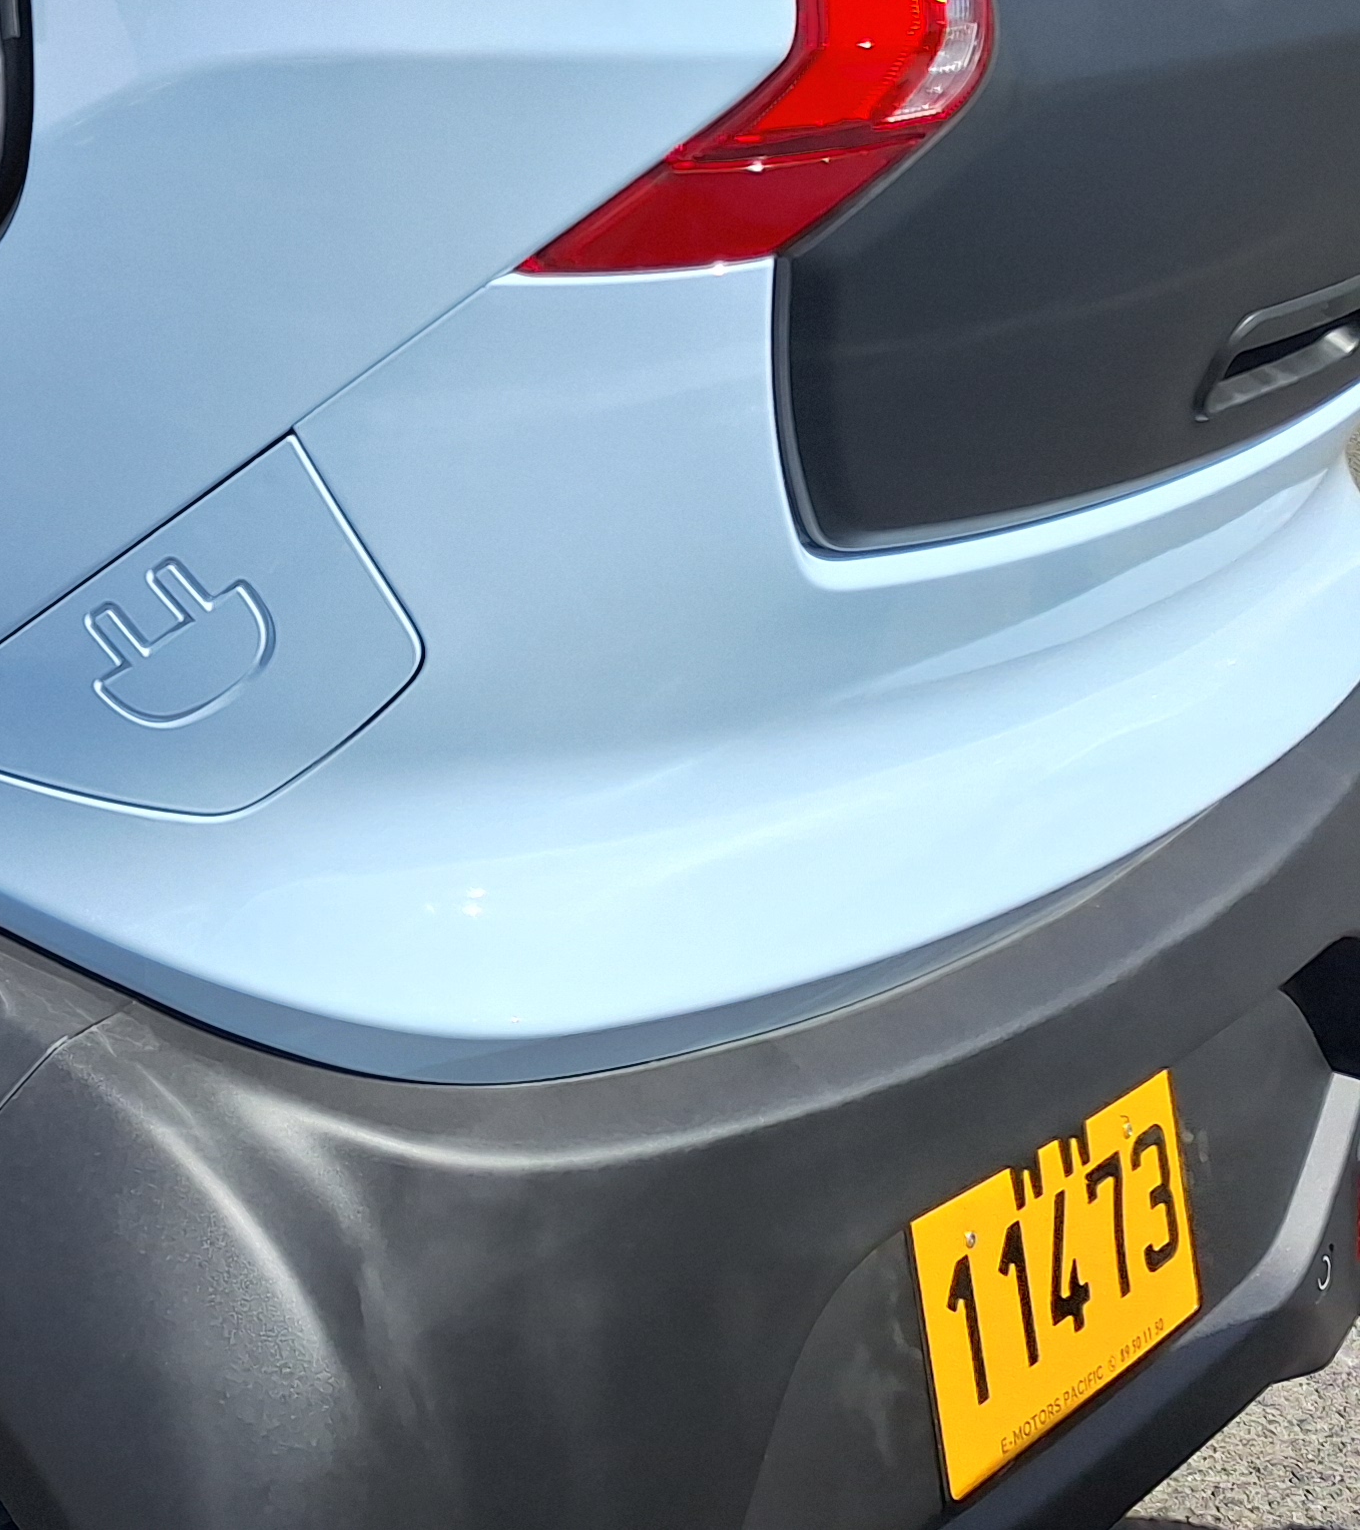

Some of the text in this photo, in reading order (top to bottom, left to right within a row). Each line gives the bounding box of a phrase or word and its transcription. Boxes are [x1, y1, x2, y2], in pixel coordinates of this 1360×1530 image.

[946, 1124, 1180, 1406] 11473
[1000, 1398, 1061, 1454] E-MOTORS
[1063, 1365, 1104, 1405] PACIFIC
